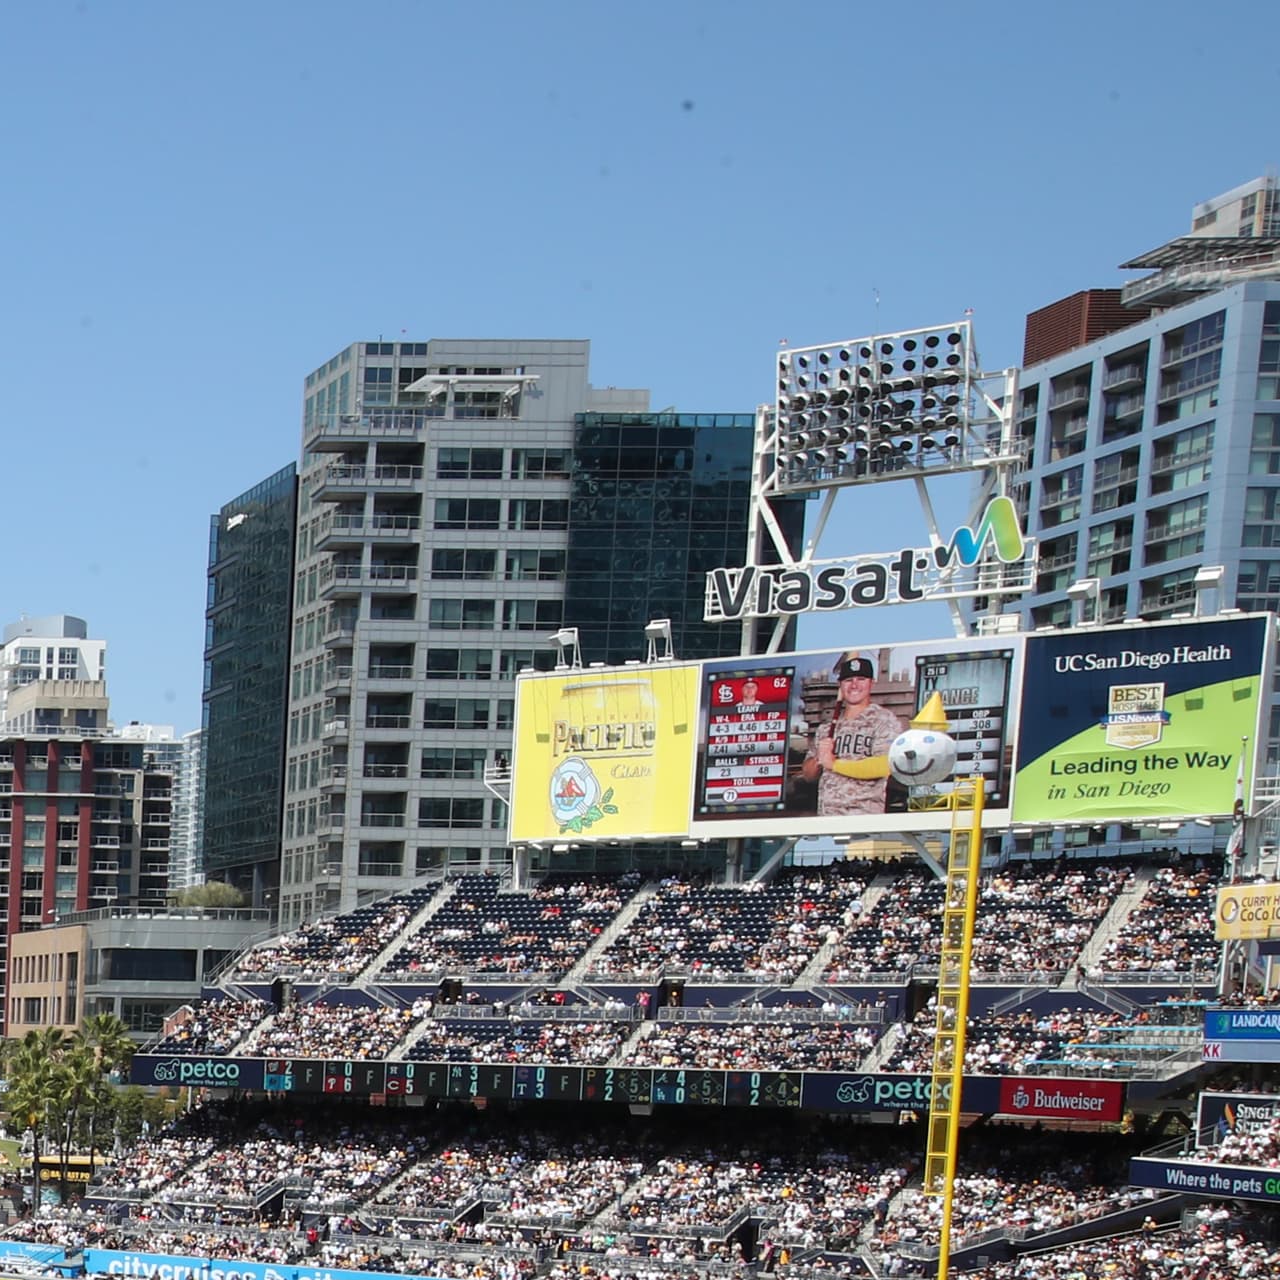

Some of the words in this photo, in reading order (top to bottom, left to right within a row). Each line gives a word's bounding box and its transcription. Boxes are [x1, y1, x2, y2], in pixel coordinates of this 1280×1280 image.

[713, 550, 924, 618] Viasat
[1055, 655, 1083, 672] UC
[1085, 654, 1117, 670] San
[1119, 651, 1170, 669] Diego
[1173, 645, 1231, 664] Health
[1112, 686, 1160, 702] BEST
[715, 758, 738, 766] BALLS
[749, 755, 779, 765] STRIKES
[1050, 757, 1137, 775] Leading
[1144, 754, 1178, 770] the
[1185, 752, 1233, 770] Way
[1048, 785, 1066, 799] in
[1074, 783, 1110, 799] San
[1119, 781, 1171, 798] Diego
[1241, 896, 1271, 908] CURRY
[1240, 908, 1269, 922] CoCo
[180, 1060, 240, 1080] petco
[1034, 1089, 1105, 1110] Budweiser
[1166, 1169, 1206, 1187] Where
[1209, 1173, 1230, 1189] the
[1233, 1176, 1261, 1193] pets
